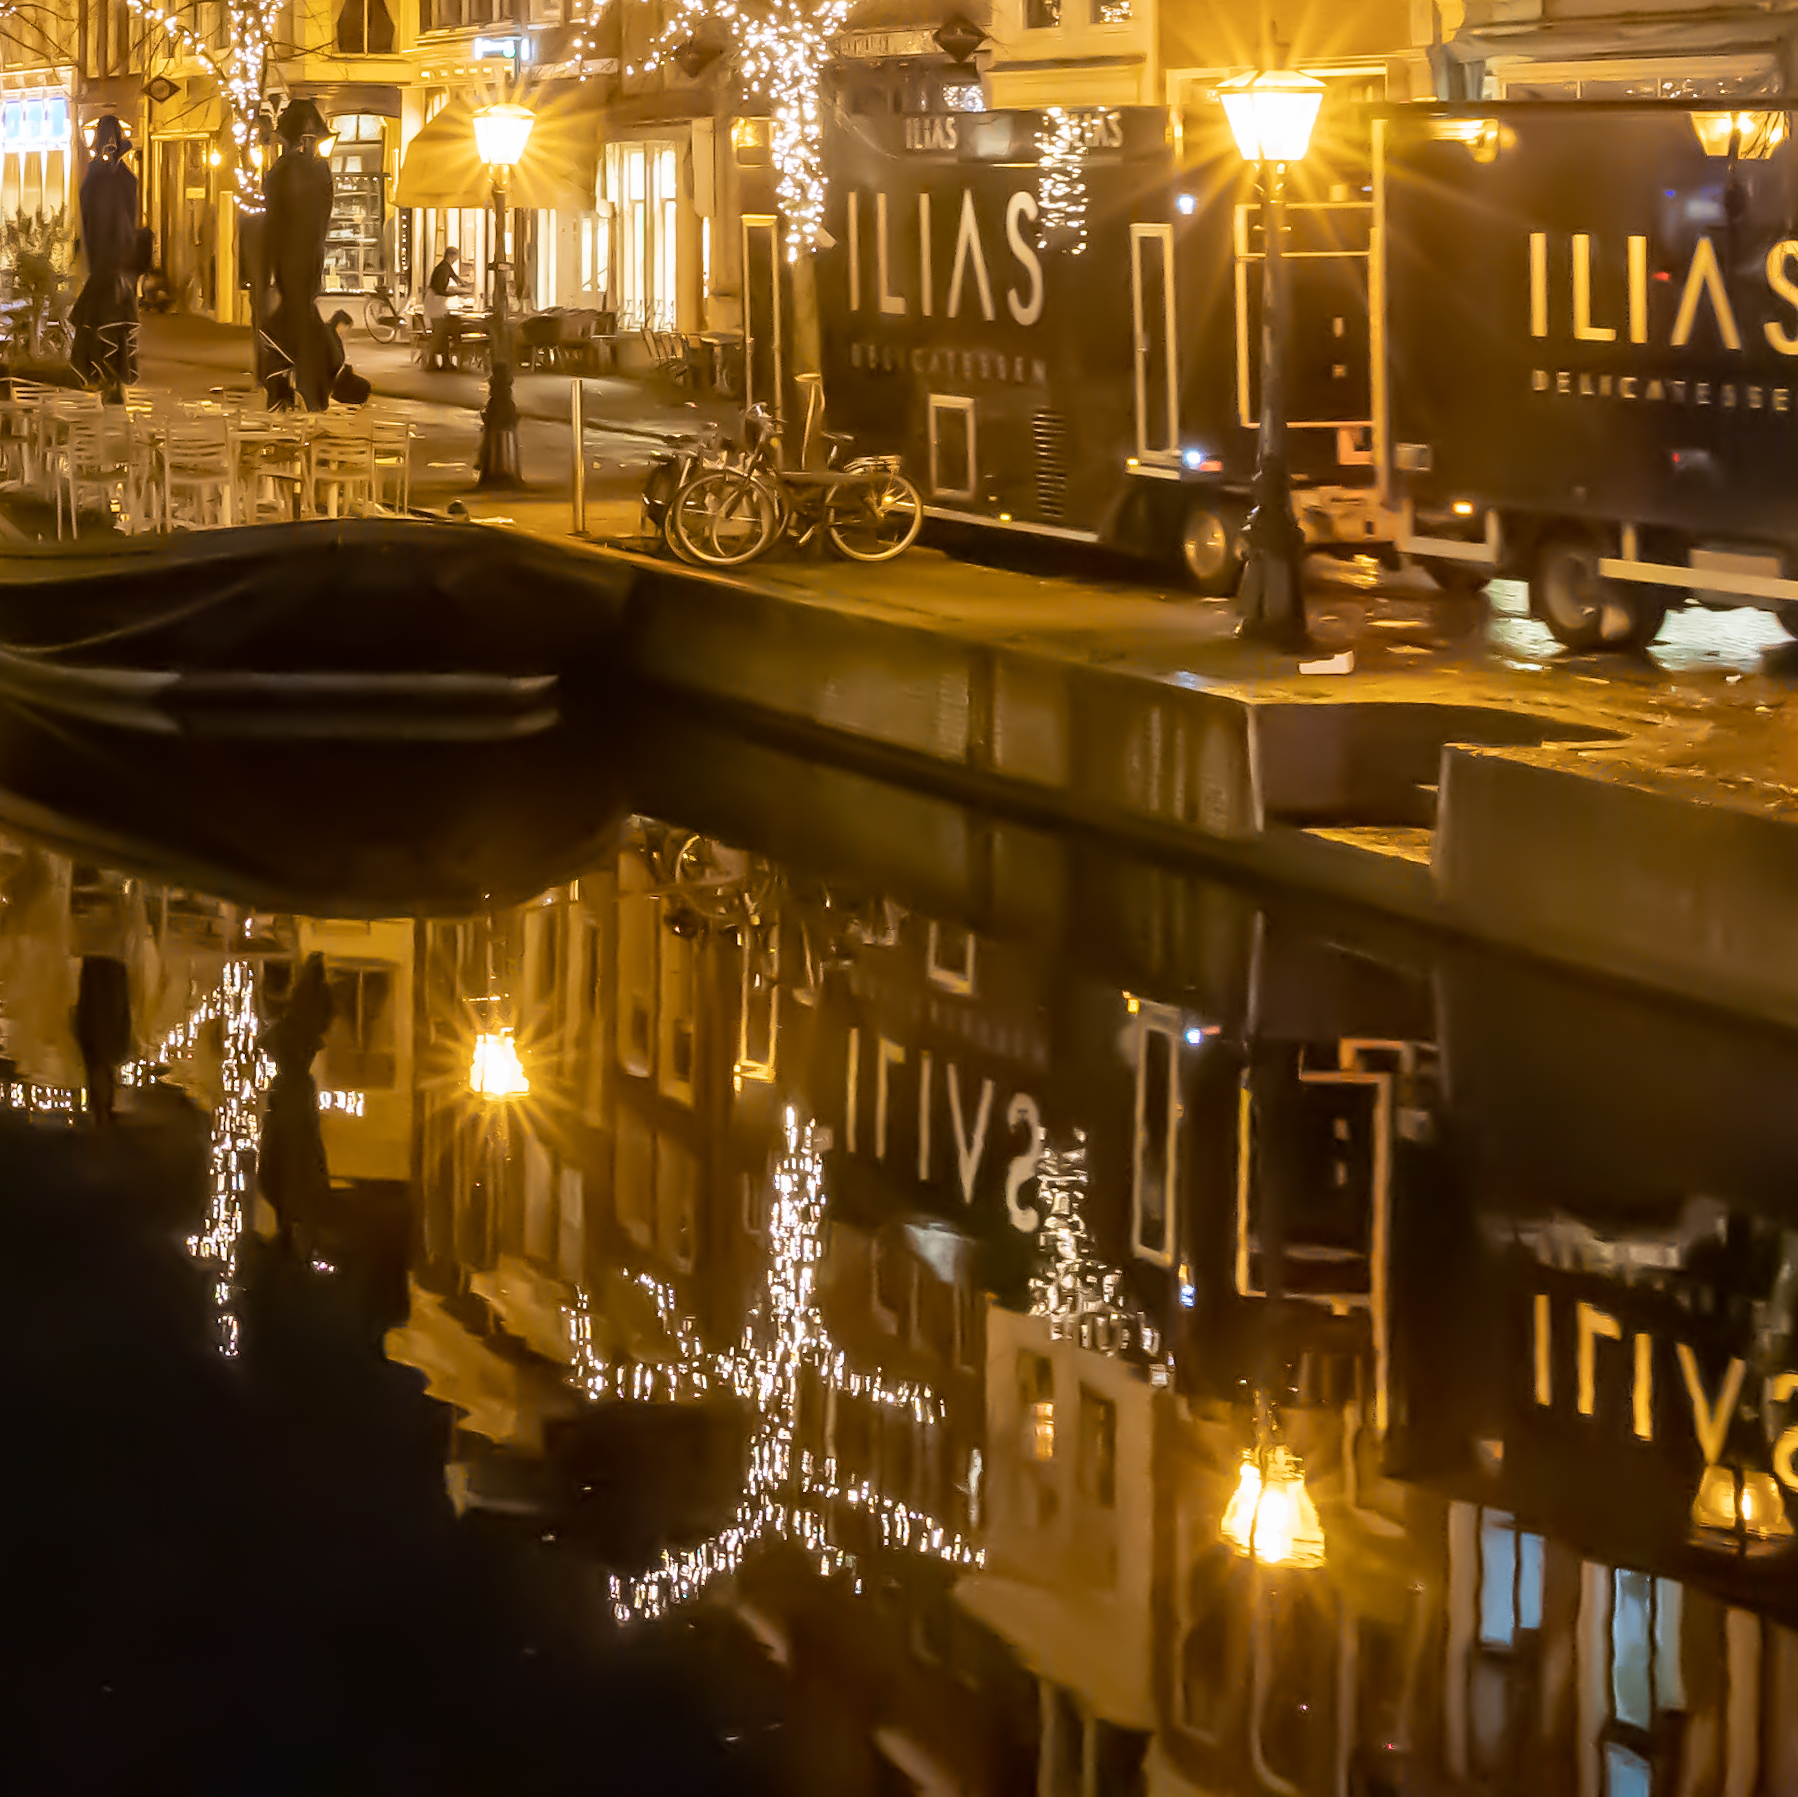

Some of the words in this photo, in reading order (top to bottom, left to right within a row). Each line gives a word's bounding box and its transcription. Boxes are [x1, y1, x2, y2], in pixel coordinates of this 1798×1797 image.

[905, 115, 958, 150] ILIAS
[847, 187, 1044, 326] ILIAS
[1529, 232, 1798, 356] ILIAS
